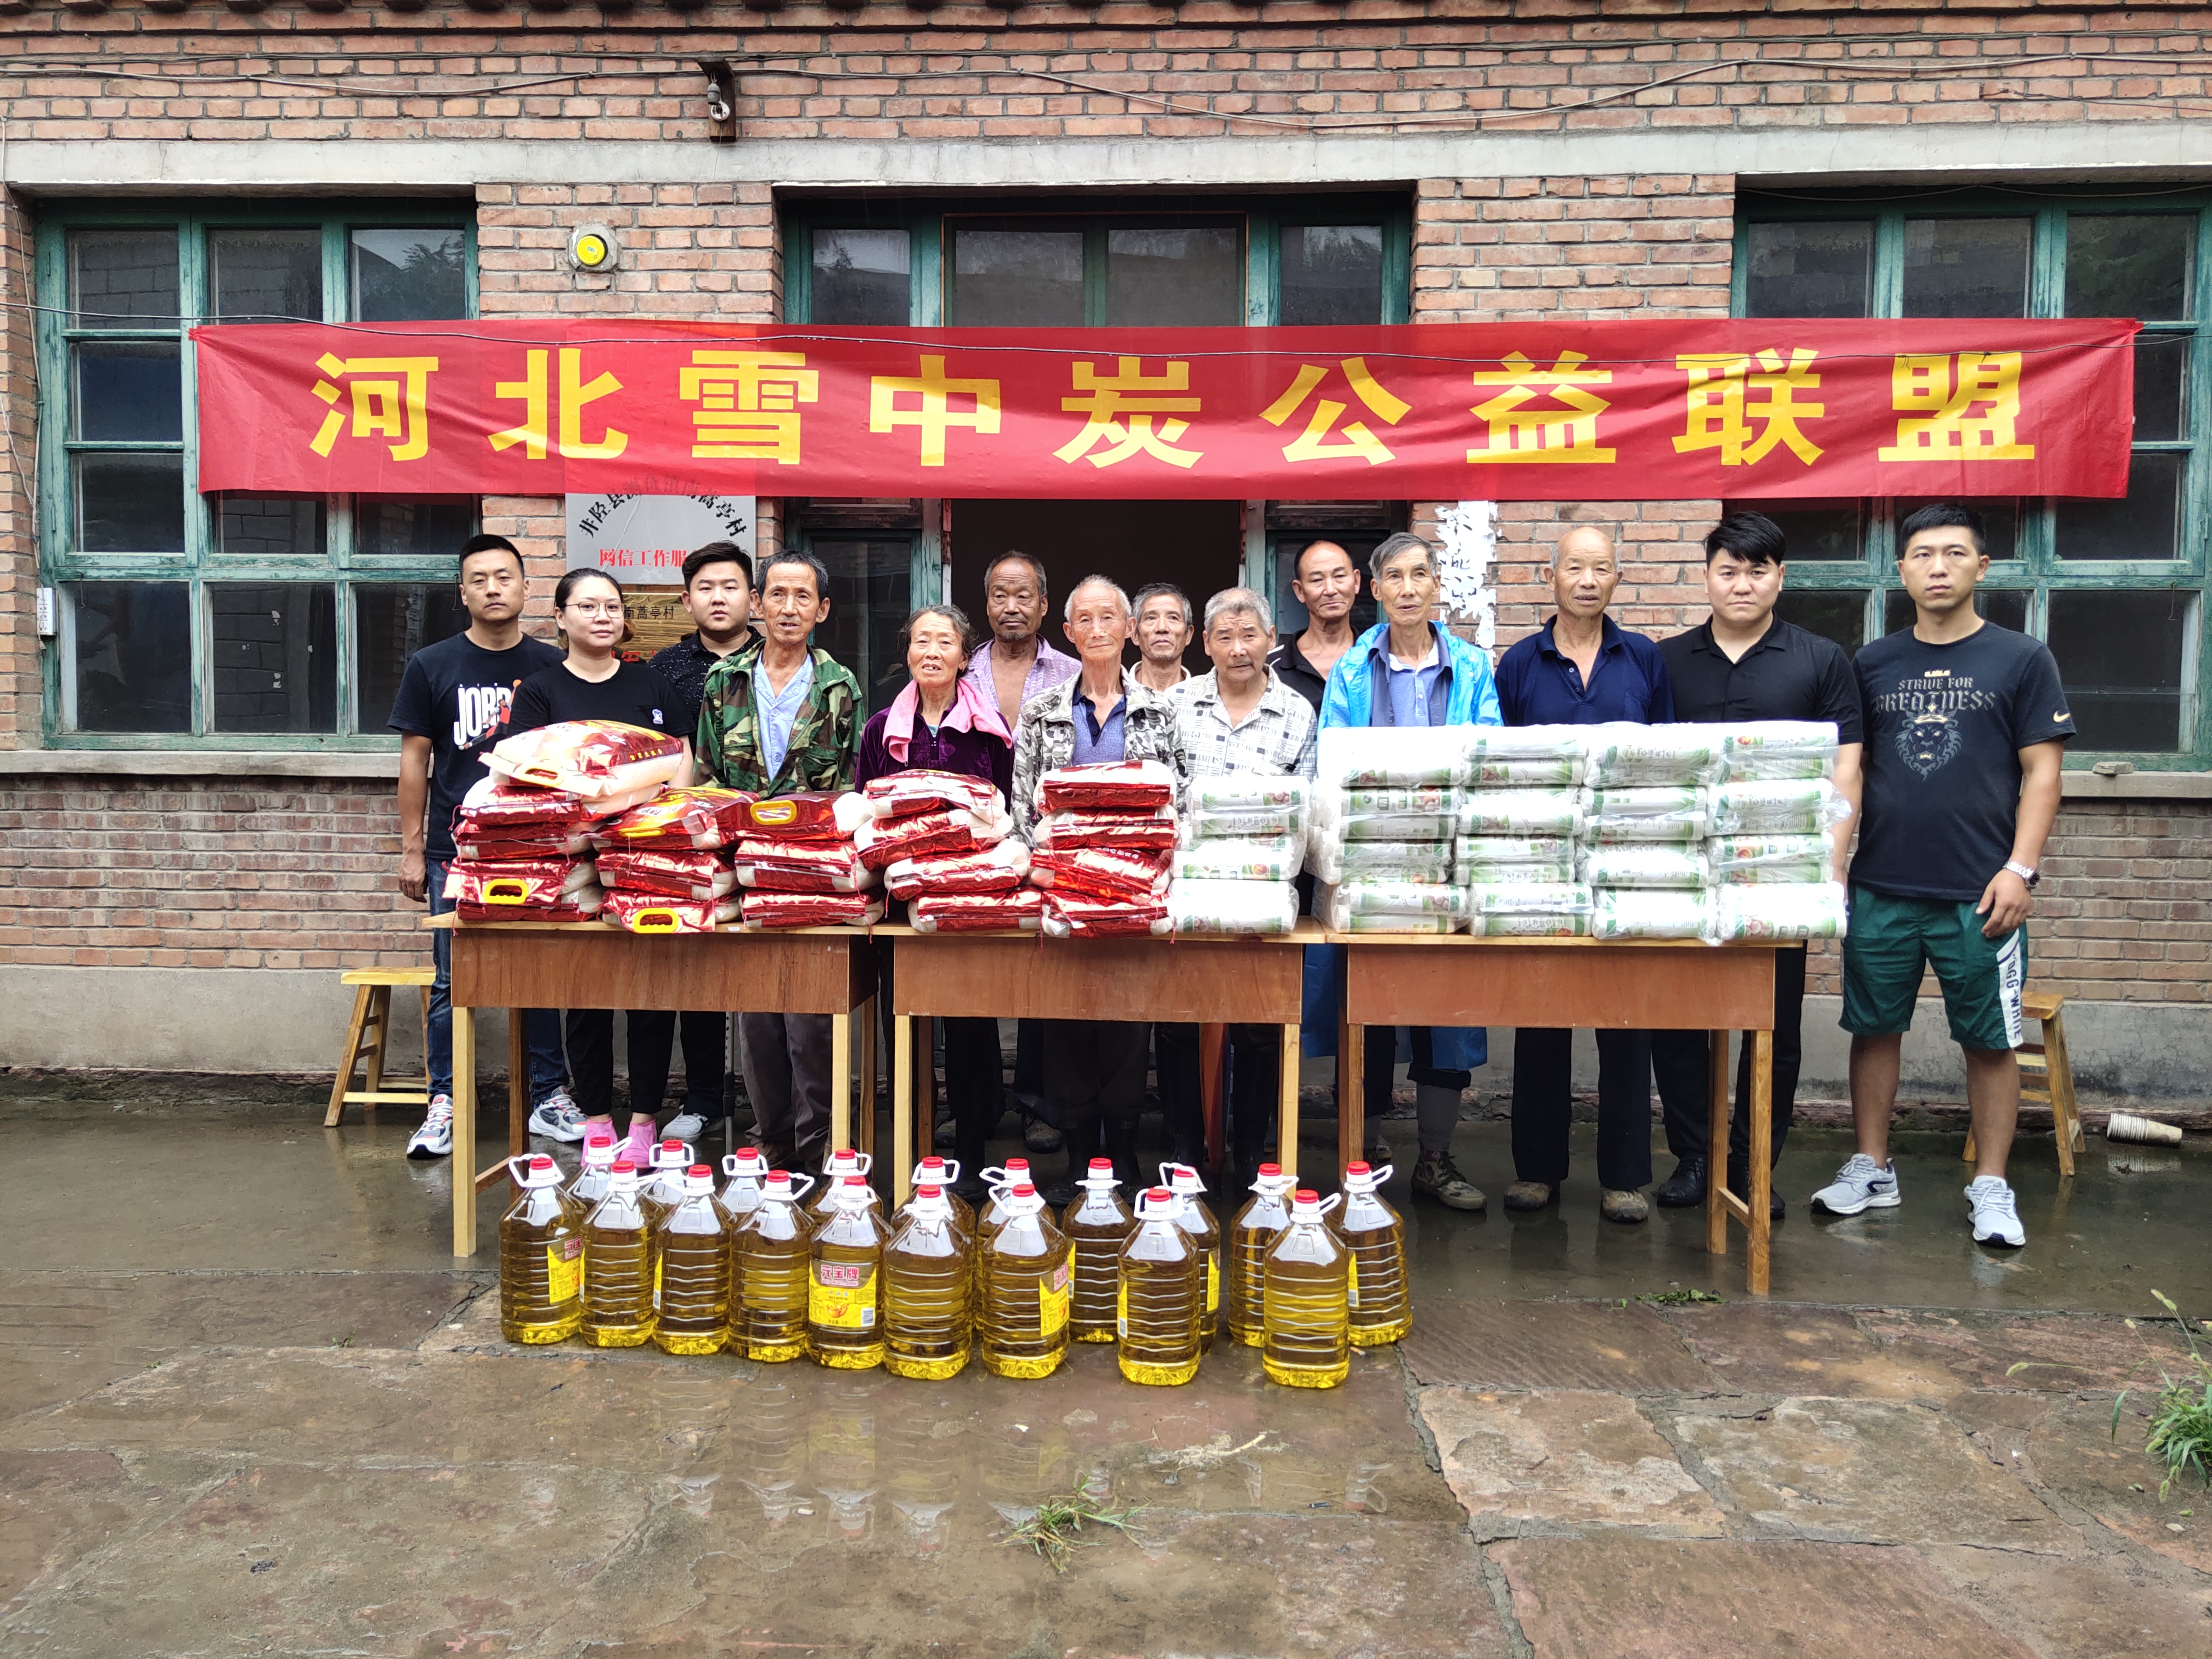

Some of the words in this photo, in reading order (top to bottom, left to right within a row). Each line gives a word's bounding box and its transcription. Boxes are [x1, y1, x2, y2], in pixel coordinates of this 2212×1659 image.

[308, 348, 2036, 469] 河北雪中炭公益联盟
[599, 549, 687, 568] 网信工作服
[1897, 678, 1943, 690] STRIVE
[1948, 676, 1975, 689] FOR
[454, 687, 511, 745] JORD
[821, 1264, 859, 1280] 元宝牌
